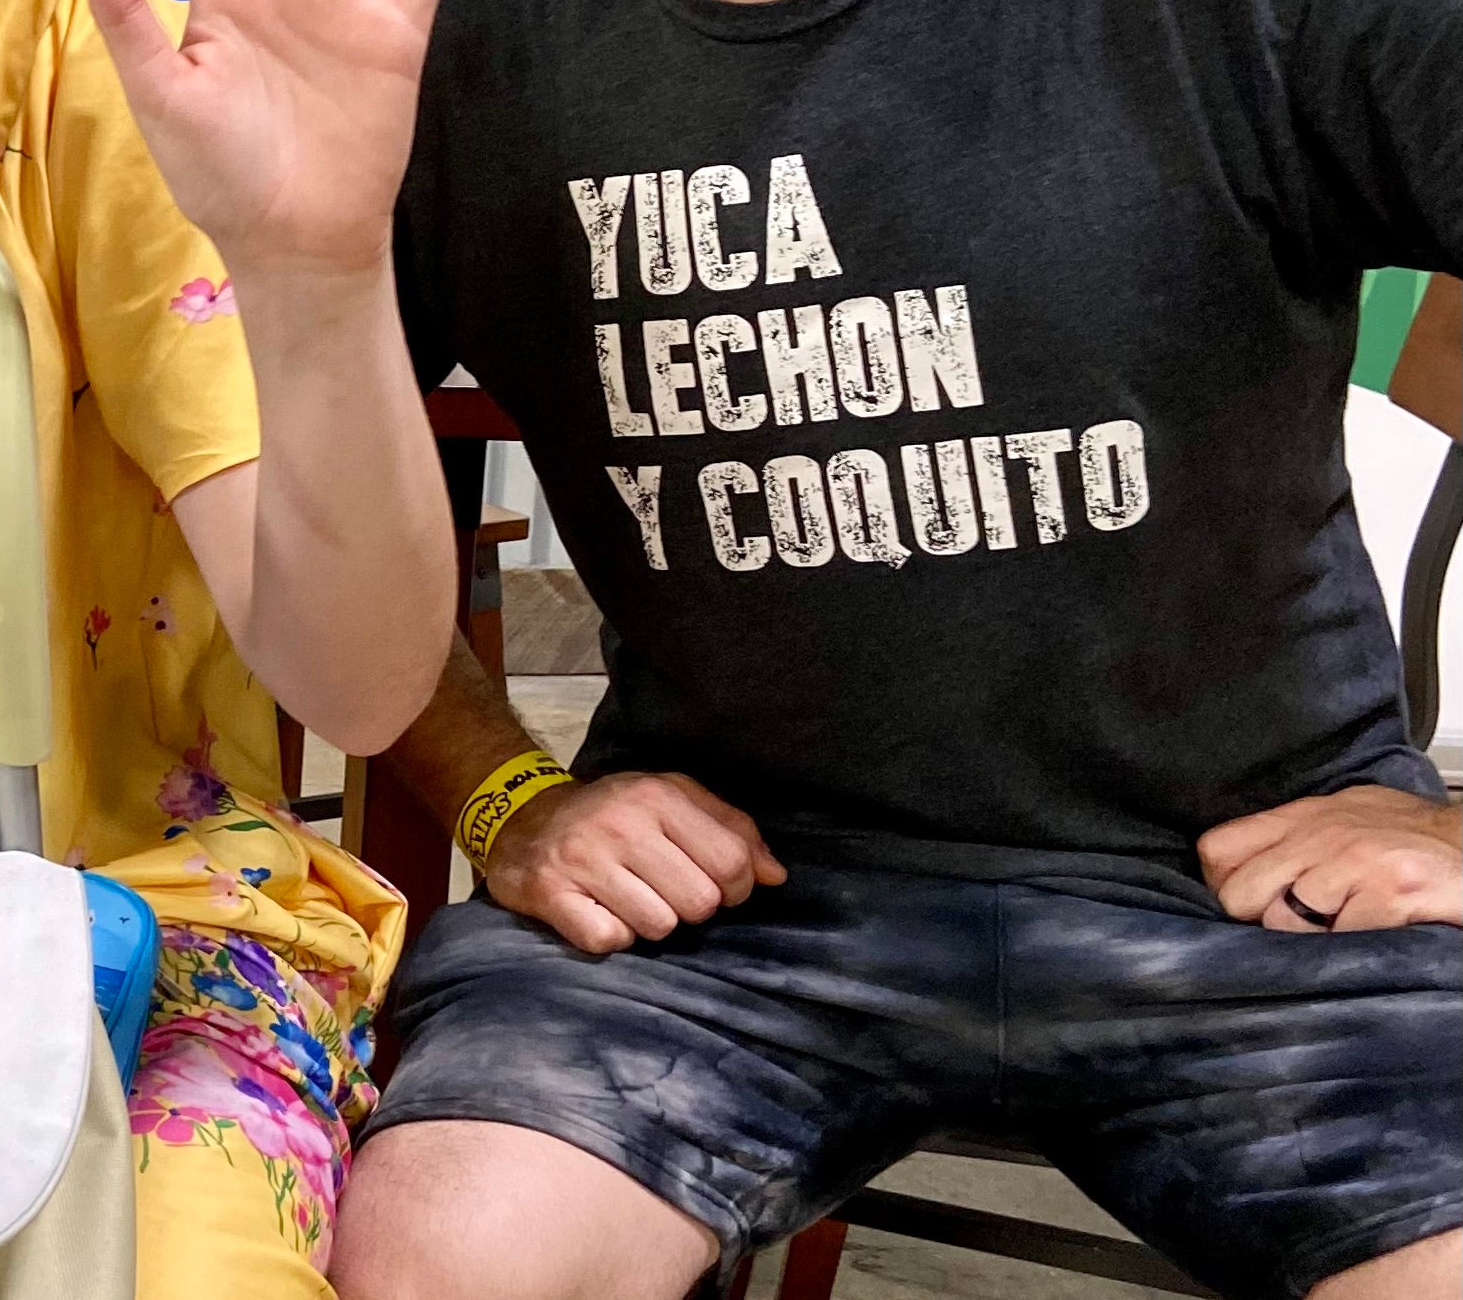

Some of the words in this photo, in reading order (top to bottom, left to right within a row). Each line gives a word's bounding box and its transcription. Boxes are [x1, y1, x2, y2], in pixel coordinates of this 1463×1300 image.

[568, 154, 843, 300] YUCA
[593, 285, 984, 438] LECHON
[605, 466, 669, 571] Y
[697, 419, 1151, 571] COQUITO
